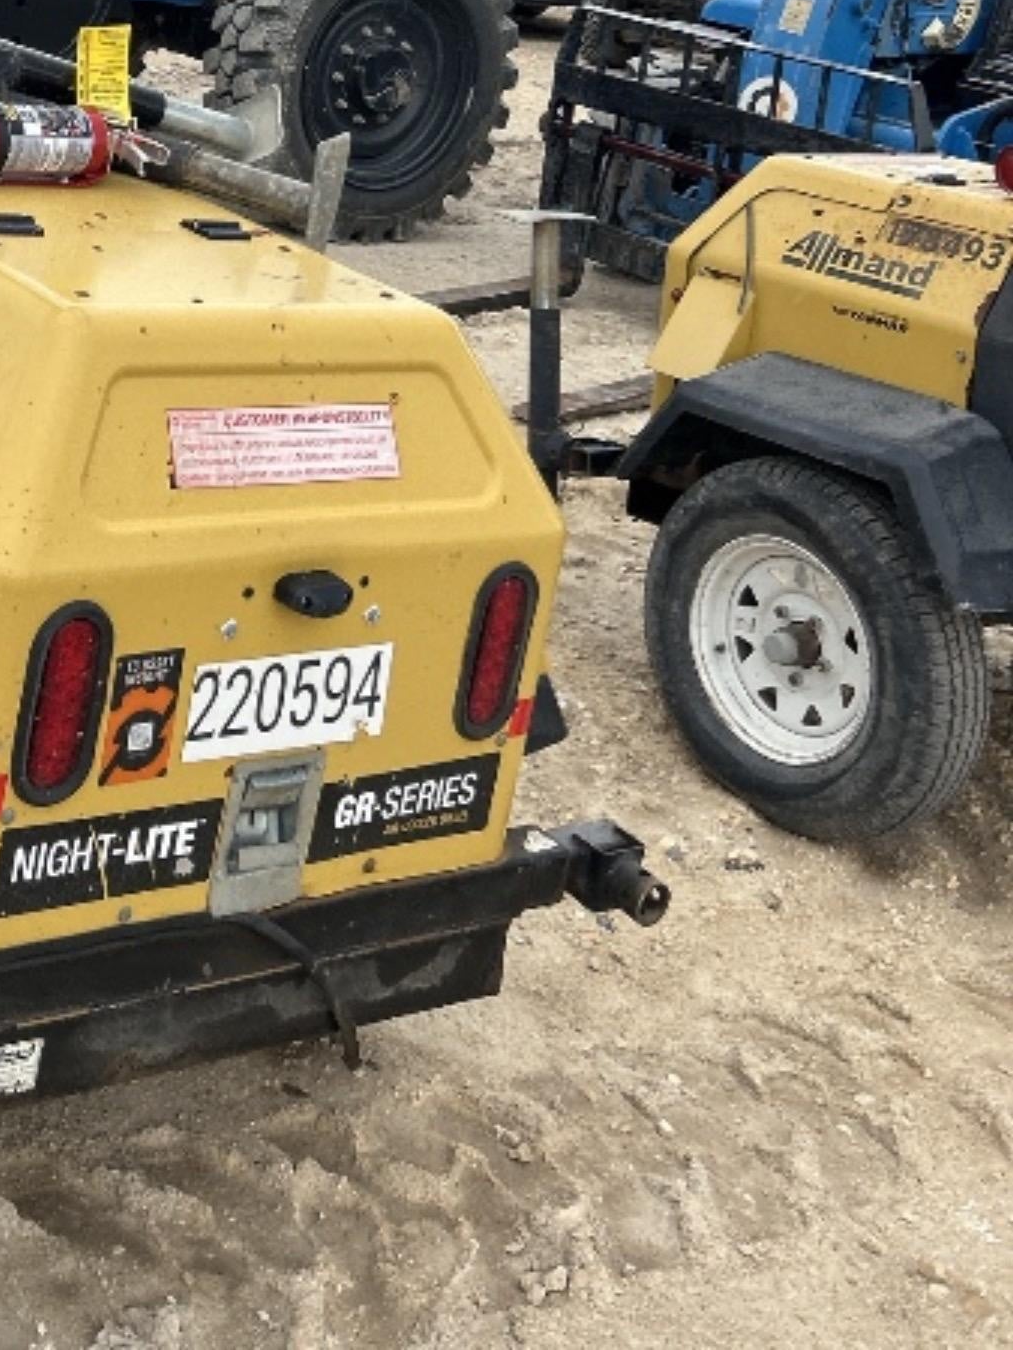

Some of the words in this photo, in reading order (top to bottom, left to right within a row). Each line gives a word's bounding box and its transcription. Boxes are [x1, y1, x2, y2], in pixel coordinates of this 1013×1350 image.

[786, 229, 940, 288] Allmand
[187, 649, 384, 742] 220594
[334, 771, 478, 830] GR-SERIES
[9, 819, 199, 884] NIGHT-LITE
